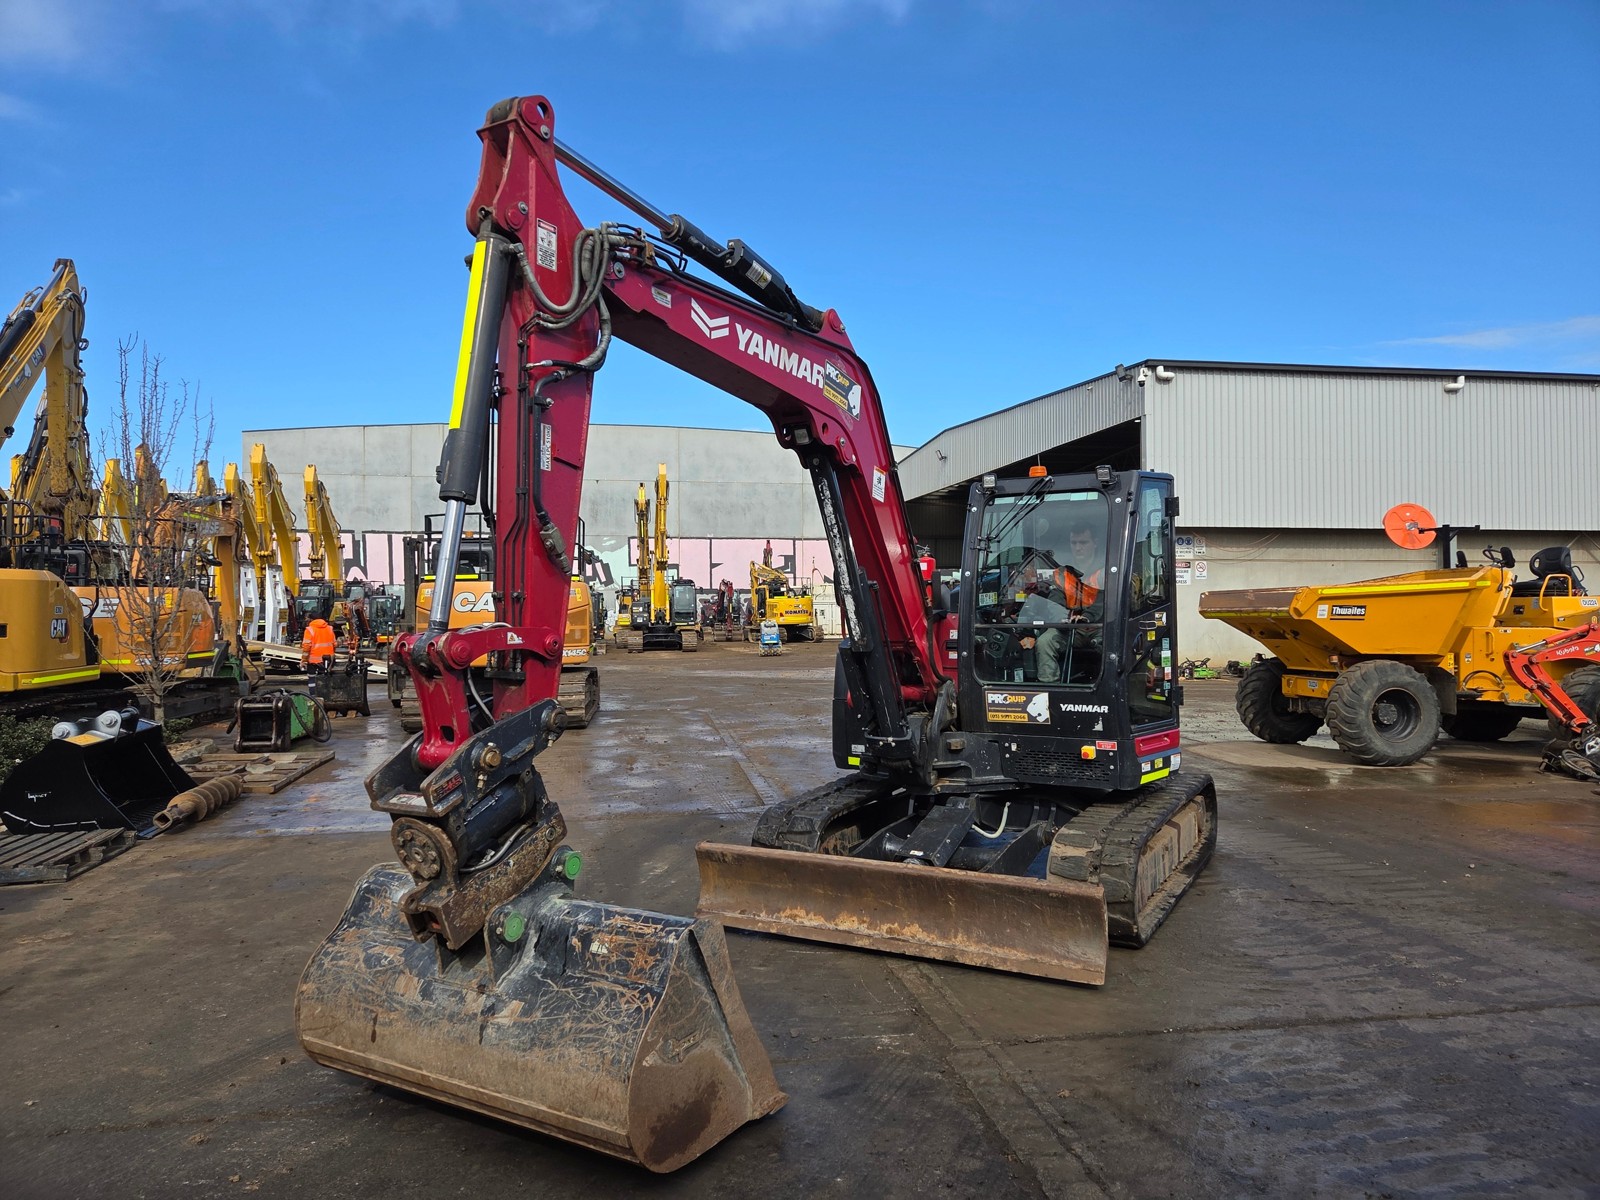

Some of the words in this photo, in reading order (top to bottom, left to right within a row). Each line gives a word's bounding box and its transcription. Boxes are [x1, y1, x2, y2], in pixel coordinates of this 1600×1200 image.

[735, 323, 825, 388] YANMAR
[453, 591, 496, 612] CA
[1332, 606, 1366, 615] Thwaites
[51, 619, 67, 638] CAT
[1556, 645, 1580, 656] Kubota
[1060, 704, 1108, 713] YANMAR
